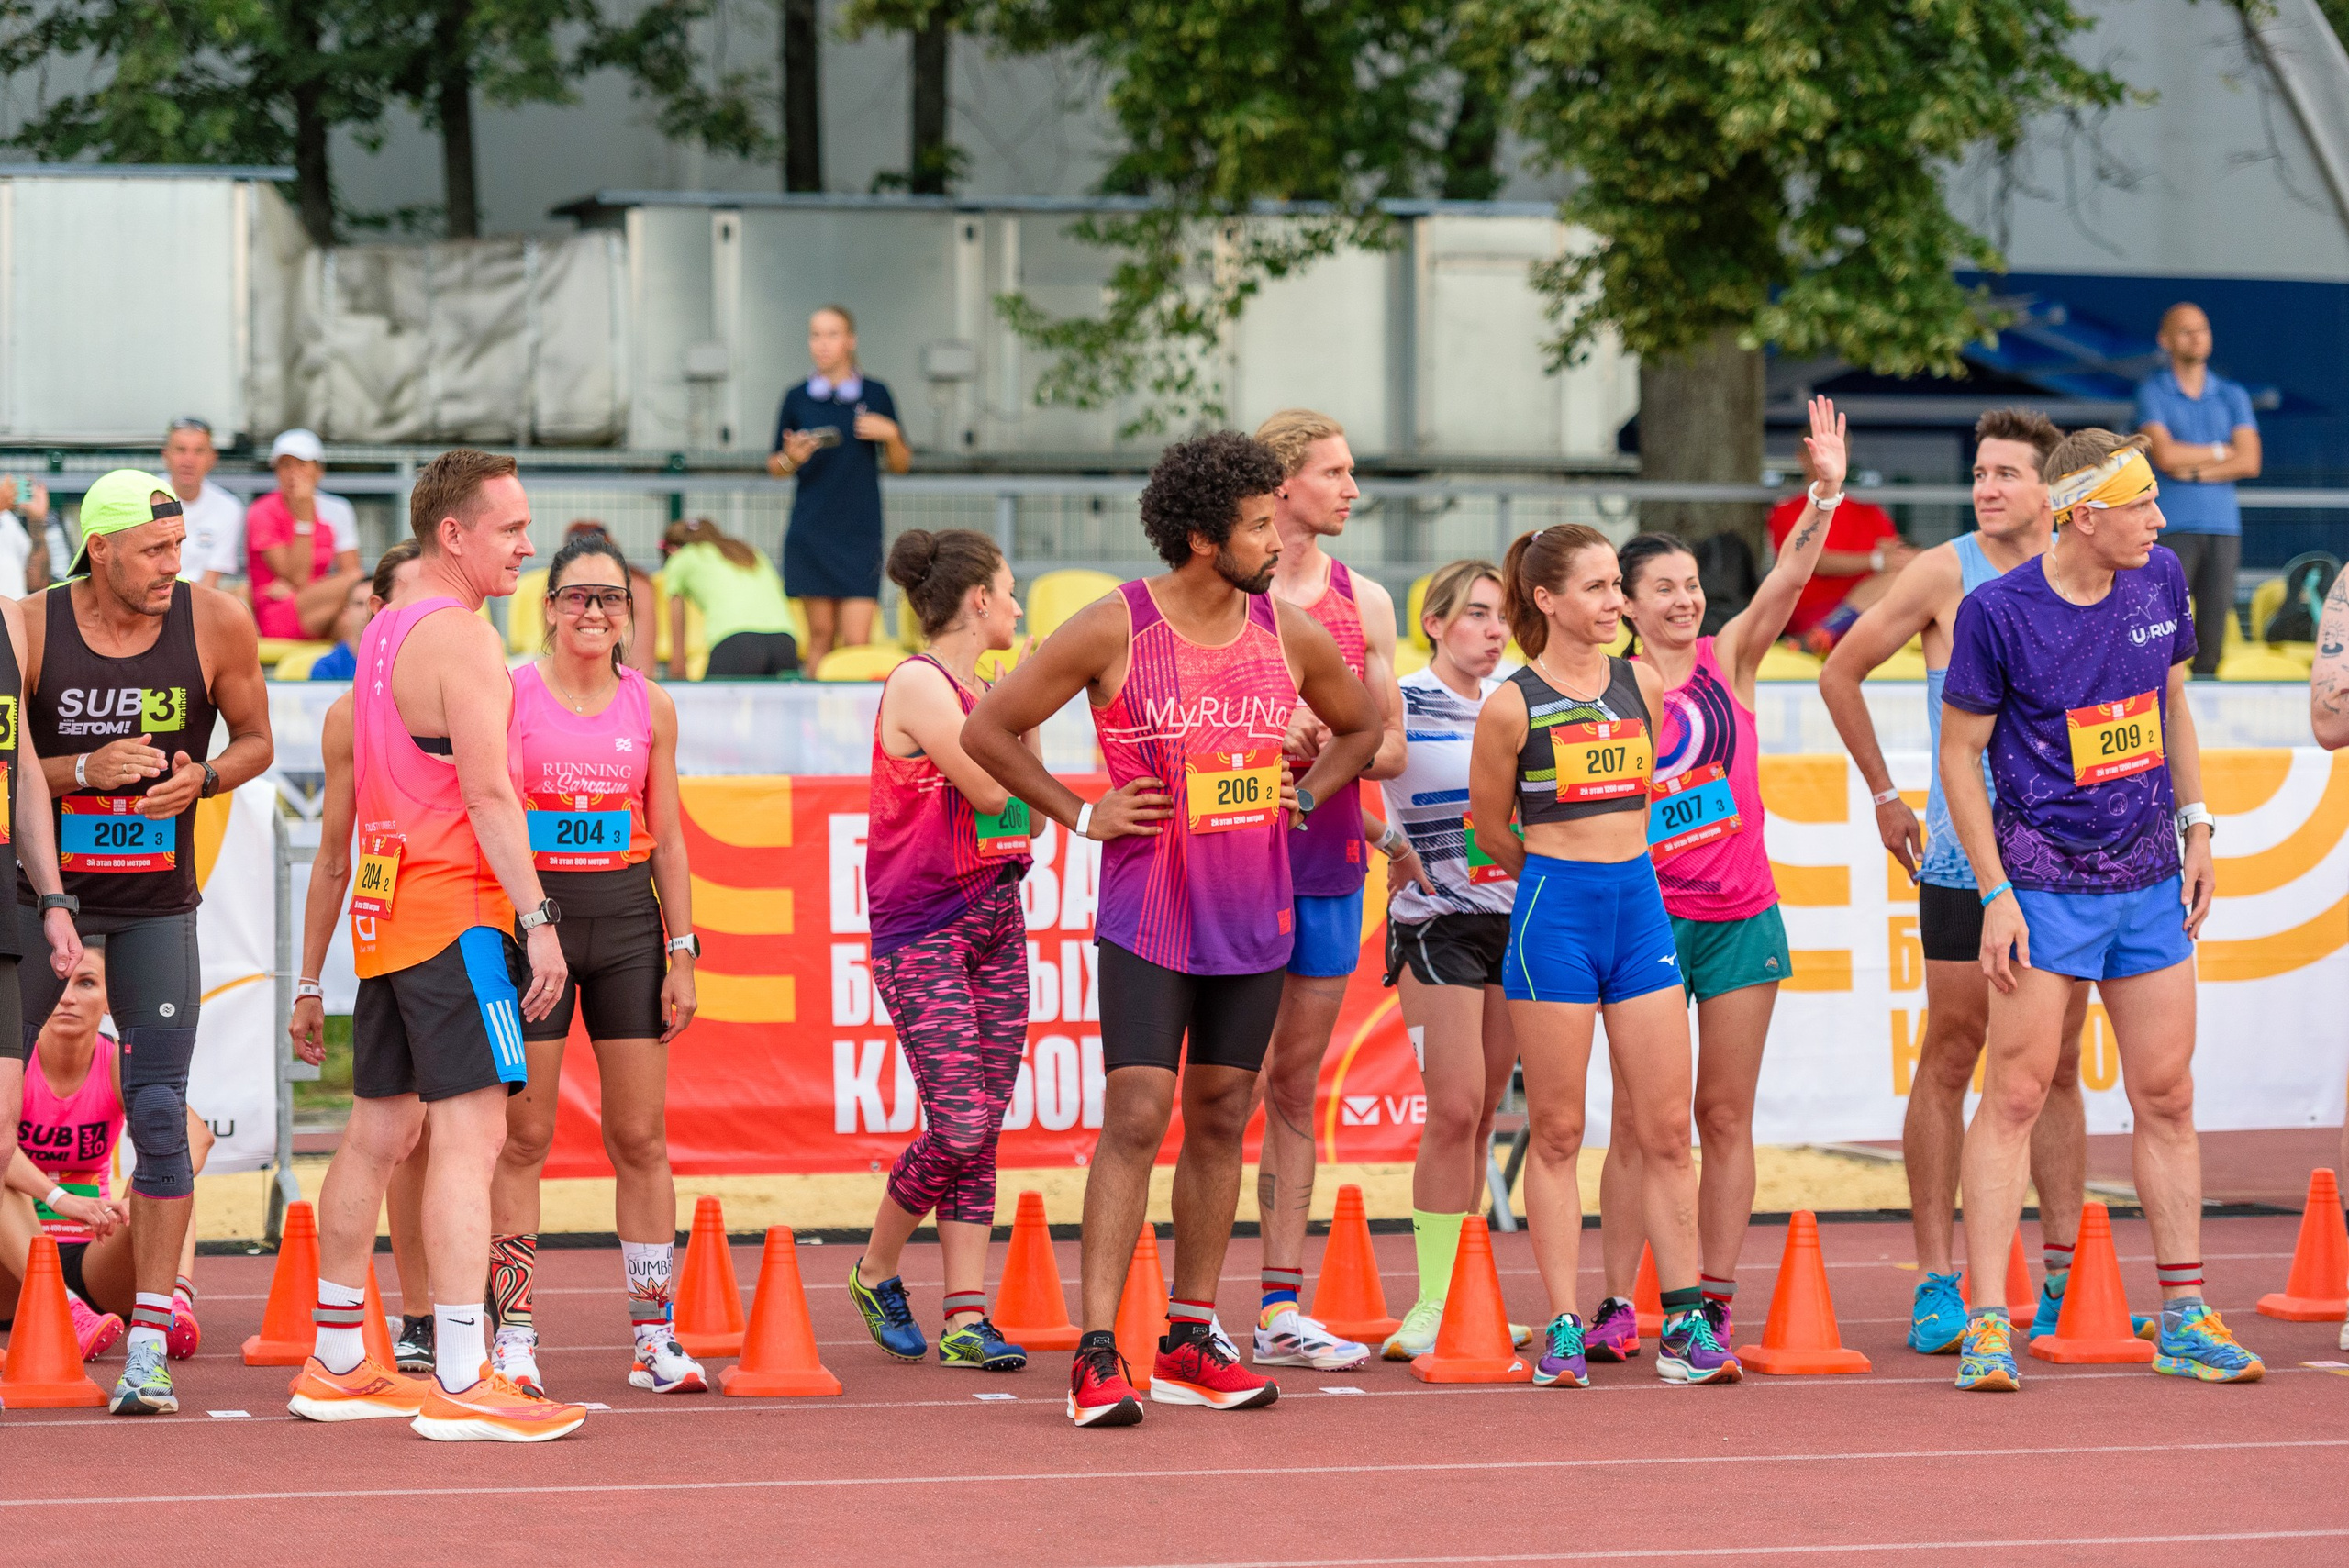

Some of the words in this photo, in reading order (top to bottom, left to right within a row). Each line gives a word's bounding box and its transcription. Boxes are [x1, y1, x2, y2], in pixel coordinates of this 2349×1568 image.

[58, 688, 142, 717] SUB
[58, 721, 131, 735] БЕГОМ!
[2100, 724, 2141, 755] 209
[2148, 730, 2154, 743] 2
[542, 762, 631, 778] RUNNING
[1586, 747, 1625, 774] 207
[1637, 757, 1642, 769] 2
[542, 781, 556, 793] &
[557, 773, 629, 794] Sarcasm
[1218, 777, 1258, 805] 206
[1266, 786, 1272, 800] 2
[999, 805, 1022, 829] 206
[1662, 795, 1702, 830] 207
[1716, 799, 1724, 811] 3
[95, 822, 144, 847] 202
[155, 833, 162, 845] 3
[557, 820, 604, 845] 204
[613, 831, 620, 843] 3
[362, 862, 382, 890] 204
[384, 878, 389, 892] 2
[828, 813, 1101, 934] БВА
[18, 1120, 73, 1147] SUB
